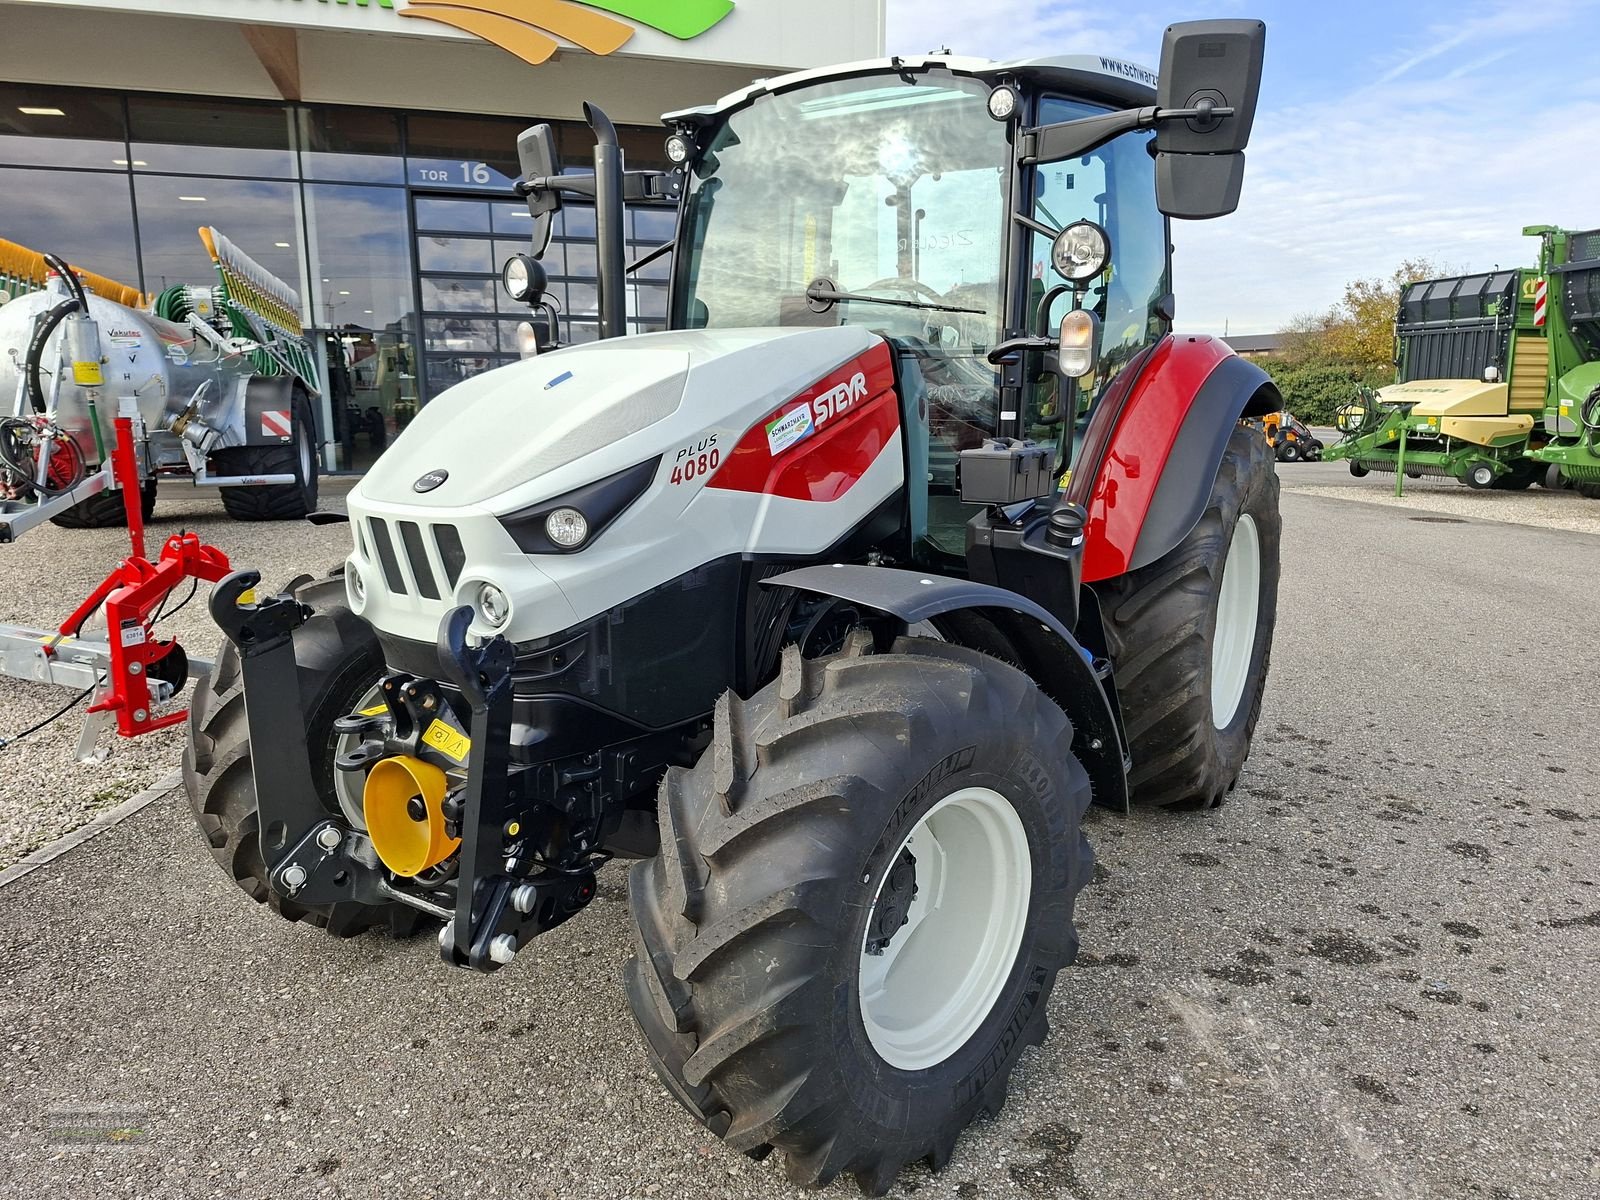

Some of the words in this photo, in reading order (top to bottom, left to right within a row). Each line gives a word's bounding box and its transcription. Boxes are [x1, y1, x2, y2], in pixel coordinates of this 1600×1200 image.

[419, 169, 448, 181] TOR
[460, 161, 490, 184] 16
[107, 328, 141, 338] Vakutec
[813, 372, 868, 427] STEYR
[771, 413, 806, 438] SCHWARZMAYR
[676, 434, 717, 462] PLUS
[670, 449, 719, 486] 4080
[884, 746, 976, 846] MICHELIN
